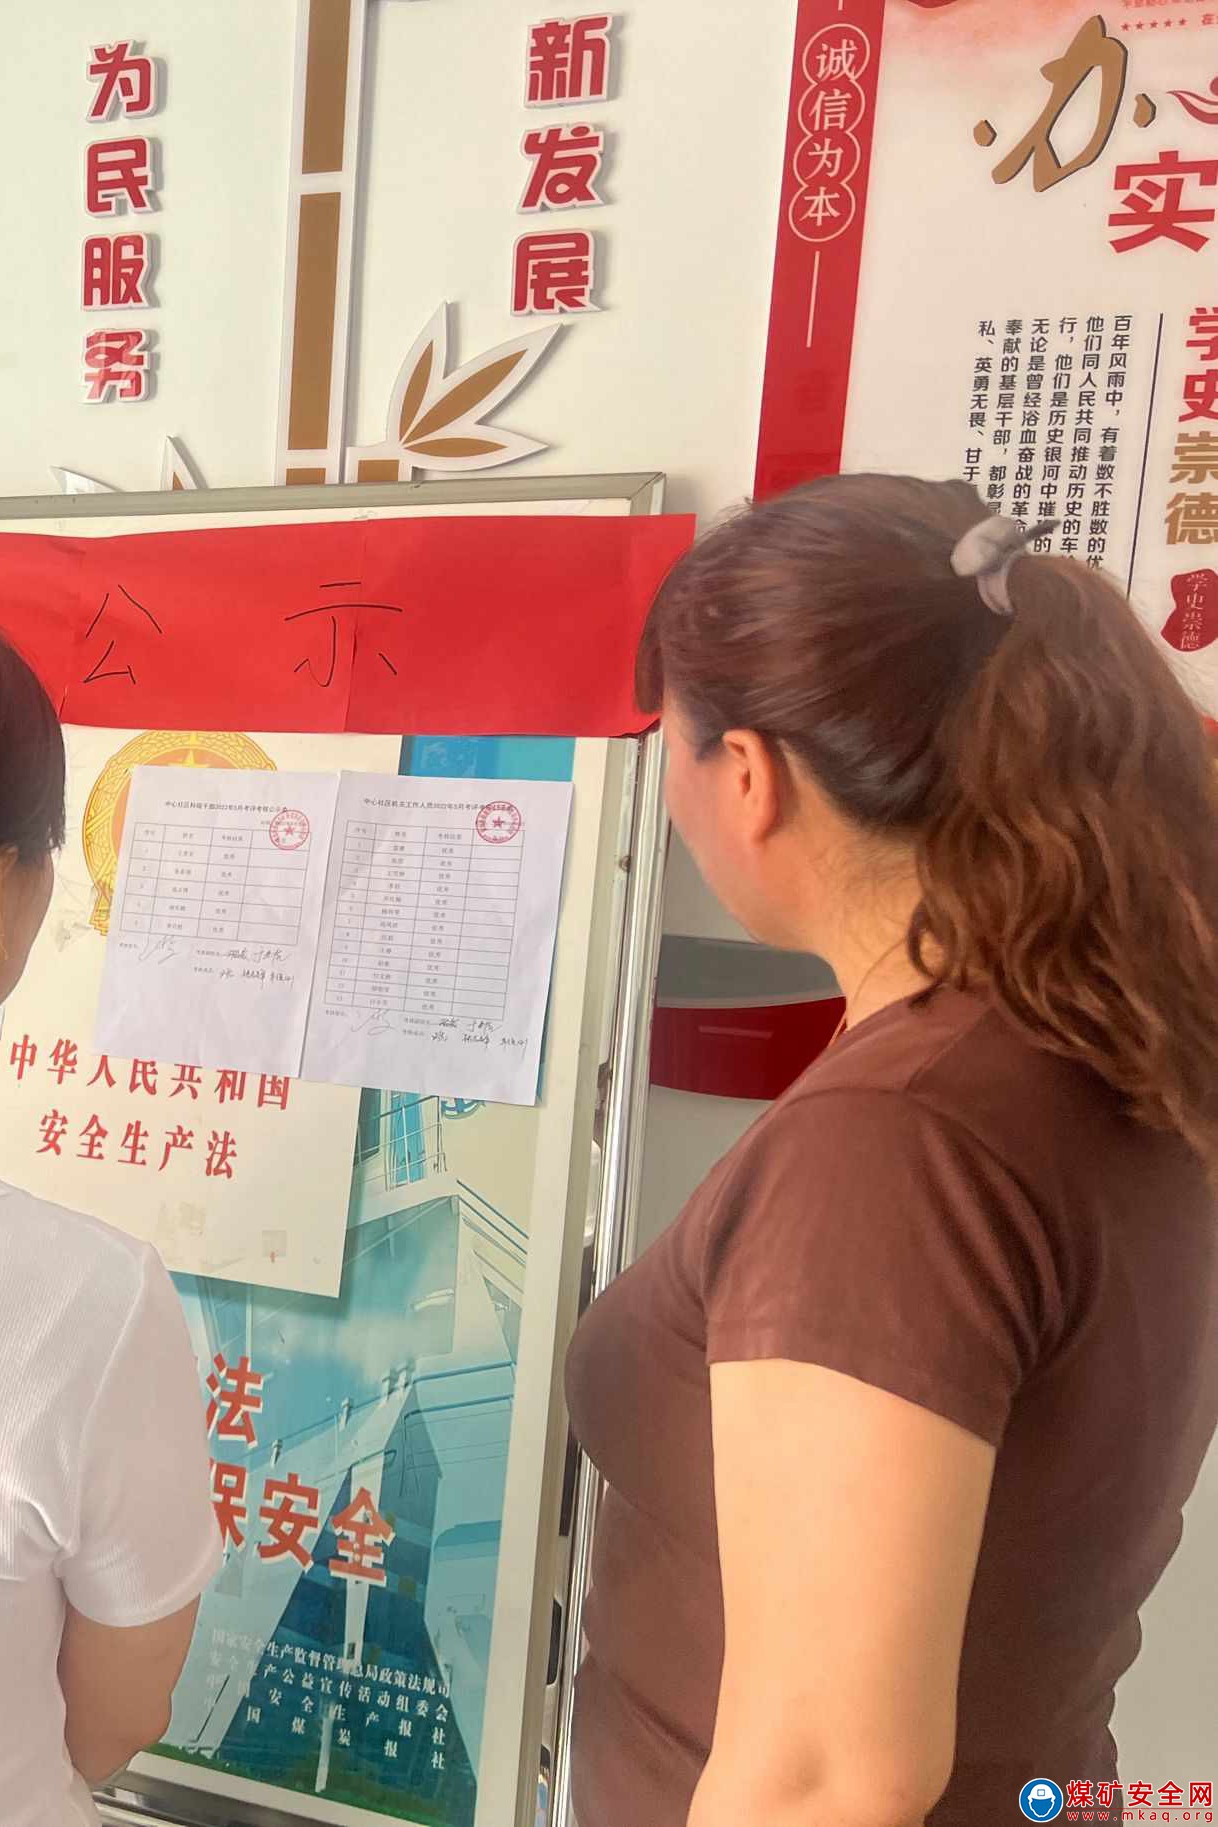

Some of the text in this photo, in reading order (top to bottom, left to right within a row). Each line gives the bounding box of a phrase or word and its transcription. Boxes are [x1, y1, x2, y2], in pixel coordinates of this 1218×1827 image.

[512, 15, 613, 314] 新发展
[799, 39, 859, 227] 诚信为本
[973, 14, 1156, 192] 办
[83, 41, 153, 401] 为民服务
[1108, 150, 1218, 253] 实
[1060, 315, 1105, 561] 他们同人民共同推动历史的车
[1164, 306, 1218, 546] 学史崇德
[83, 582, 403, 688] 公示
[9, 1033, 290, 1110] 中华人民共和国
[36, 1109, 238, 1179] 安全生产法
[206, 1353, 263, 1447] 法
[209, 1457, 396, 1587] 保安全
